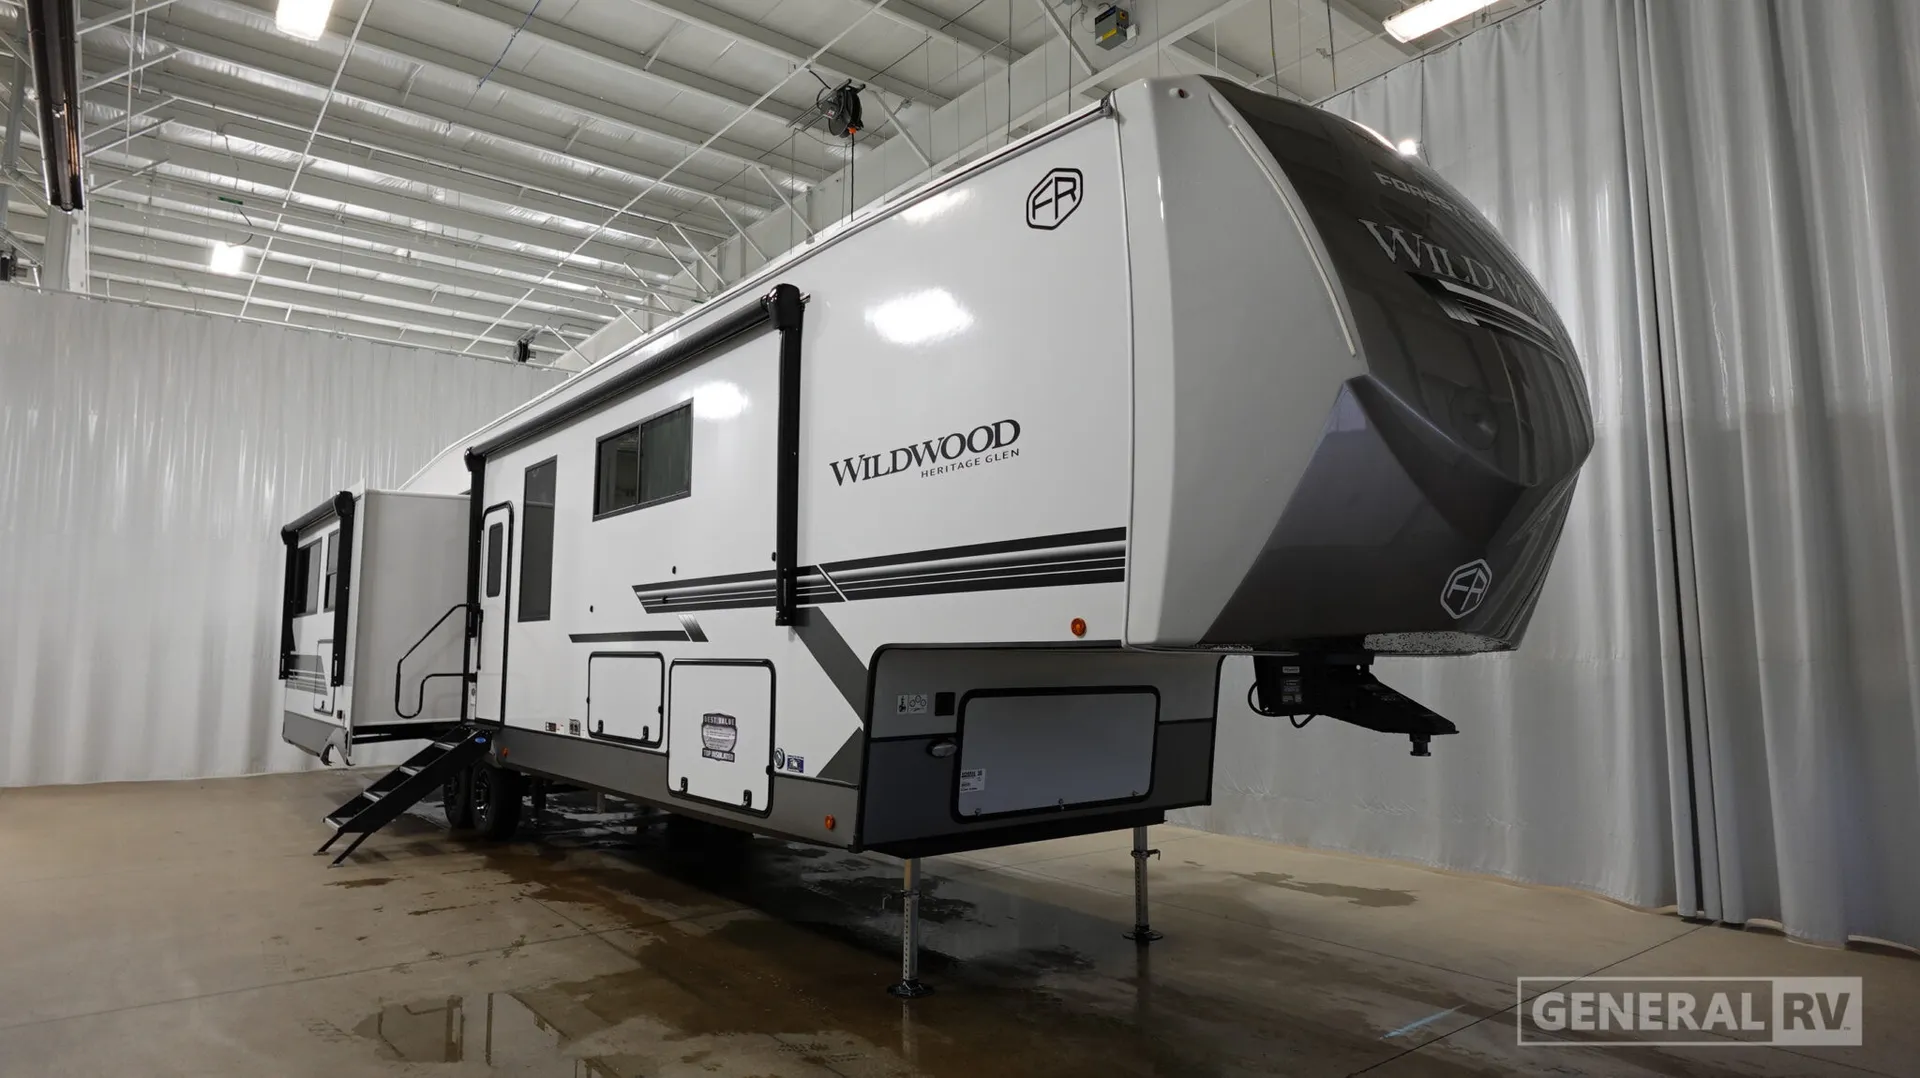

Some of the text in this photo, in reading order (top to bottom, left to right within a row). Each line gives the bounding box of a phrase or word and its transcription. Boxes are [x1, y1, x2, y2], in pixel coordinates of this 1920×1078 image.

[1031, 176, 1077, 220] FR
[1372, 171, 1461, 217] FOREST
[829, 419, 1021, 486] WILDWOOD
[920, 448, 1020, 478] HERITAGE GLEN
[1446, 567, 1488, 611] FR
